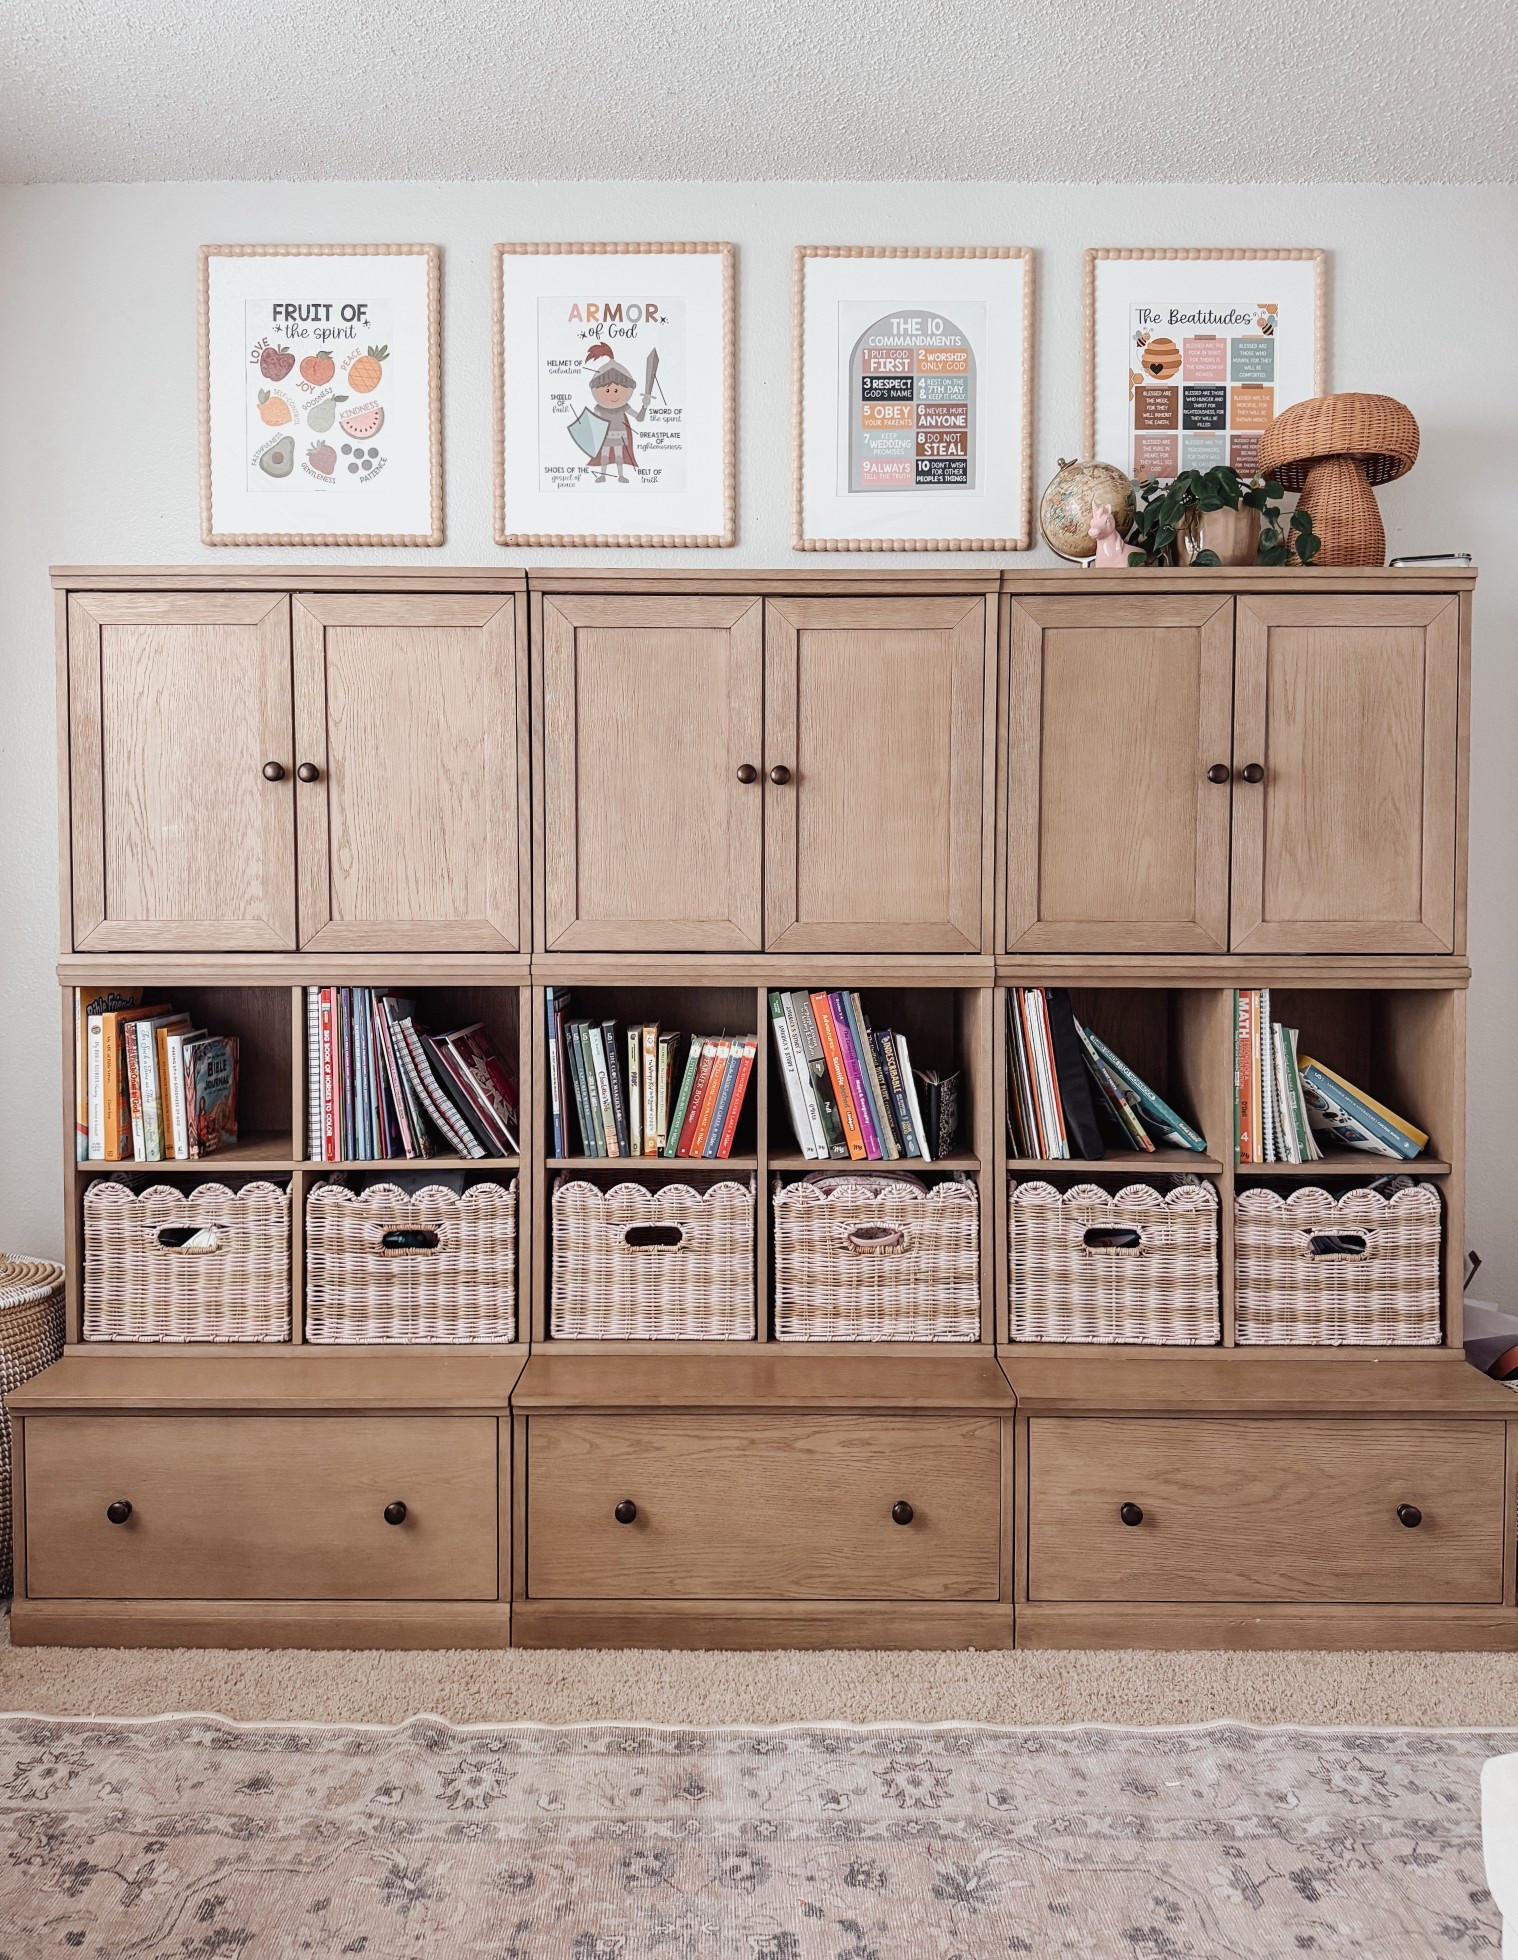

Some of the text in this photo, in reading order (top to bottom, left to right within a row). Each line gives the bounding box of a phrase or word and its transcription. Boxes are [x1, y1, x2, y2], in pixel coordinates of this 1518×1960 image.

[273, 304, 368, 322] FRUIT OF
[568, 303, 659, 323] ARMOR
[1135, 308, 1253, 325] The Beatitudes
[285, 323, 357, 343] the spirit
[588, 322, 638, 340] of God
[891, 318, 944, 334] THE 10
[869, 336, 962, 346] COMMANDMENTS
[250, 337, 270, 363] LOVE
[864, 349, 909, 359] 1 PUT GOD
[918, 349, 967, 361] 2 WORSHIP
[340, 348, 362, 371] PEACE
[871, 359, 910, 372] FIRST
[921, 362, 966, 370] ONLY GOD
[296, 380, 316, 394] JOY
[863, 378, 912, 388] 3 RESPECT
[918, 378, 926, 387] 4
[302, 387, 333, 410] GOODNESS
[919, 389, 927, 399] &
[273, 388, 300, 425] SELF-CONTROL
[340, 400, 379, 419] KINDNESS
[863, 406, 910, 418] 5 OBEY
[918, 405, 925, 415] 6
[662, 415, 682, 423] spirit
[918, 416, 966, 426] ANYONE
[863, 434, 870, 444] 7
[869, 440, 912, 449] WEDDING
[918, 433, 961, 443] 8 DO NOT
[251, 432, 283, 466] FAITHFULNESS
[637, 443, 682, 452] righteousness
[924, 443, 964, 455] STEAL
[301, 462, 336, 484] GENTLENESS
[360, 457, 388, 483] PATIENCE
[863, 461, 911, 472] 9 ALWAYS
[917, 461, 930, 471] 10
[1239, 997, 1249, 1039] MATH
[785, 1006, 799, 1048] AMERICA'S STORY
[801, 1015, 814, 1057] Living Education
[809, 1026, 817, 1046] Lessons
[778, 1025, 789, 1051] AMERICA'S
[785, 1052, 793, 1067] STORY
[822, 1014, 844, 1086] Adventures Scientific
[141, 1030, 153, 1103] For Such Time This
[208, 1059, 227, 1077] BIBLE
[324, 1064, 331, 1073] OF
[697, 1059, 709, 1088] FARMER
[714, 1060, 723, 1078] LITTLE
[883, 1041, 902, 1093] INDESCRIBABLE
[204, 1076, 230, 1090] JOURNAL
[709, 1079, 718, 1095] HOUSE
[846, 1040, 855, 1060] Complete
[861, 1098, 870, 1124] Geography
[598, 1071, 610, 1112] Charlotte's Web
[692, 1090, 701, 1107] BOY
[880, 1085, 889, 1101] PARKS
[132, 1099, 140, 1113] God
[326, 1102, 332, 1111] TO
[709, 1074, 732, 1146] BANKS PLUM CREEK Wilder
[732, 1098, 740, 1115] SILVER
[674, 1111, 682, 1128] WOODS
[670, 1133, 678, 1146] Wilder
[696, 1133, 704, 1146] Wilder
[1241, 1131, 1249, 1141] 4
